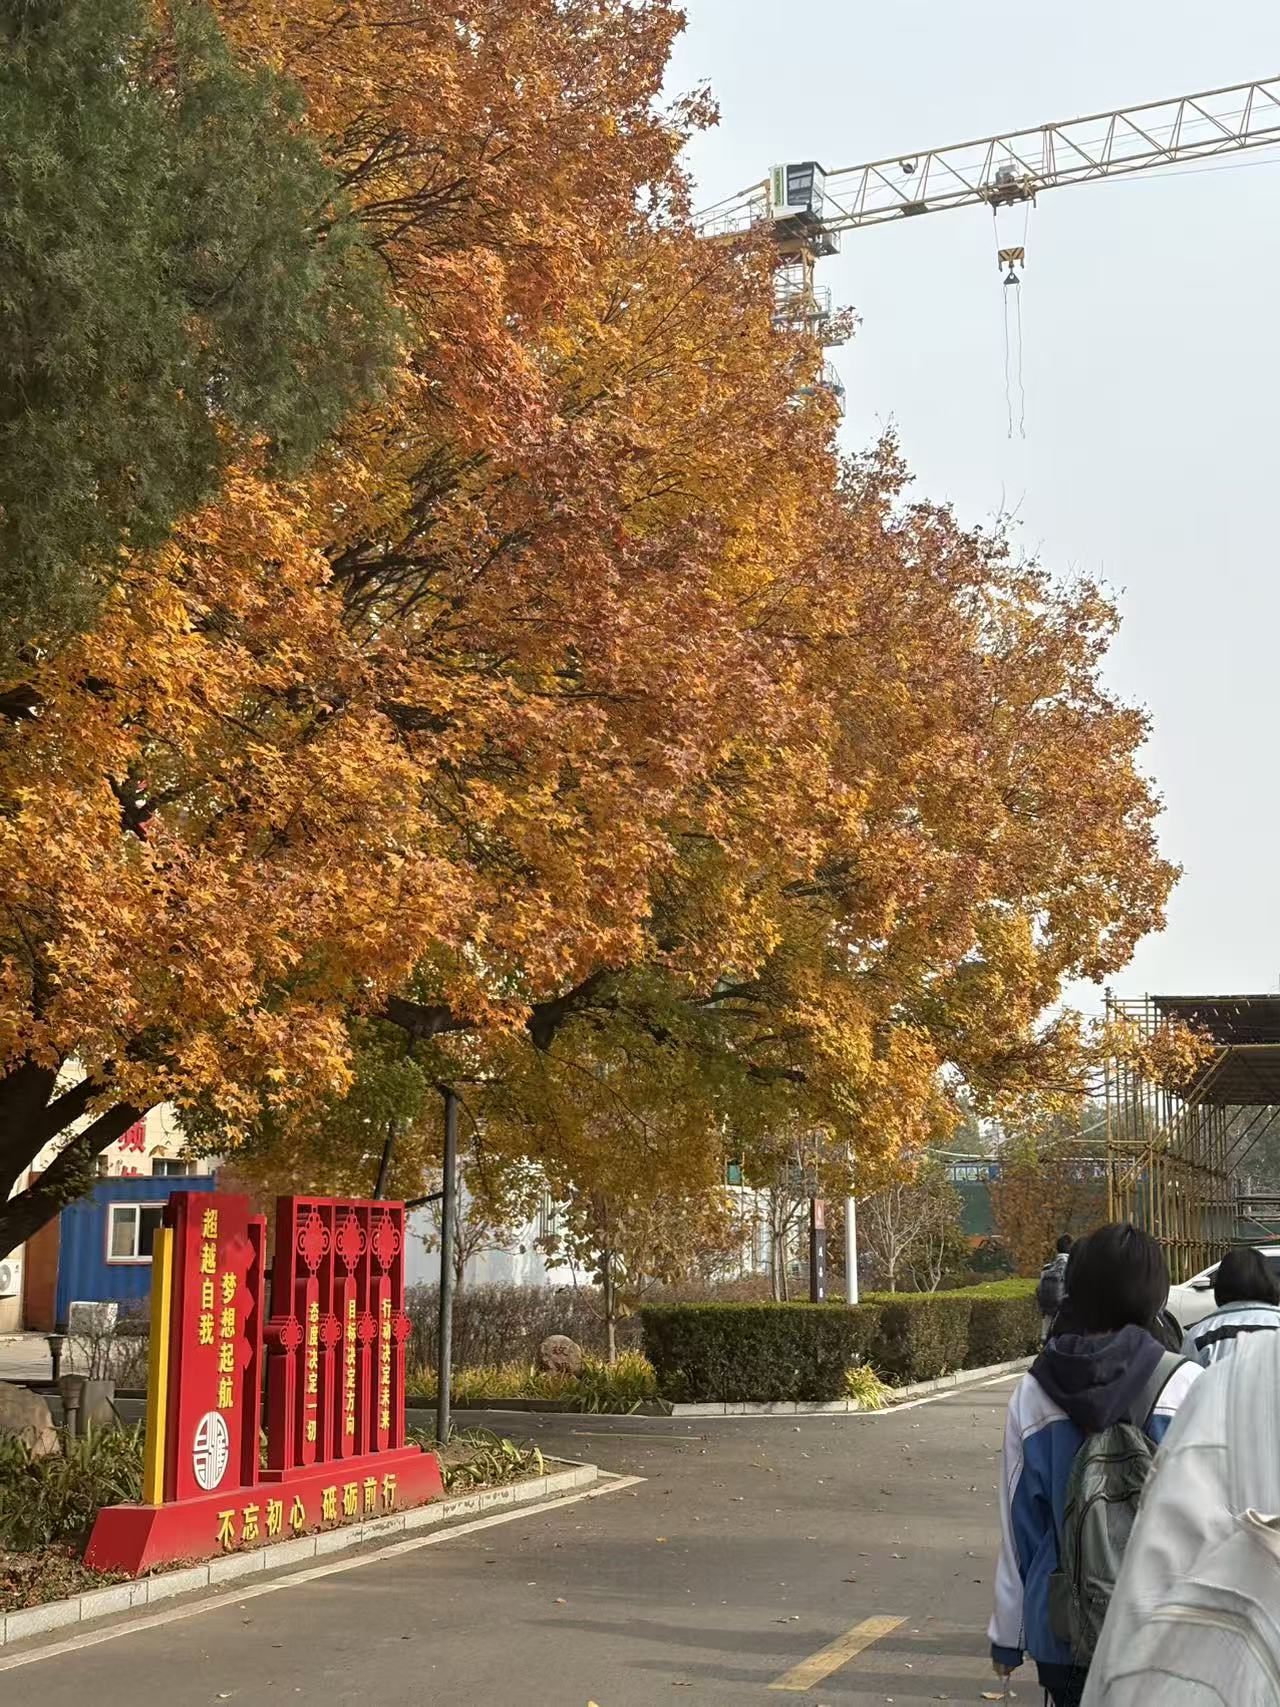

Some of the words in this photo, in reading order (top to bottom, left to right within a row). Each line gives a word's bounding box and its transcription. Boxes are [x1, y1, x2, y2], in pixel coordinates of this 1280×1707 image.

[199, 1208, 218, 1344] 超越自我
[217, 1272, 237, 1408] 梦想起航
[306, 1301, 319, 1442] 态度决定一切
[345, 1299, 357, 1435] 目标决定方向
[380, 1298, 391, 1430] 行动决定未来
